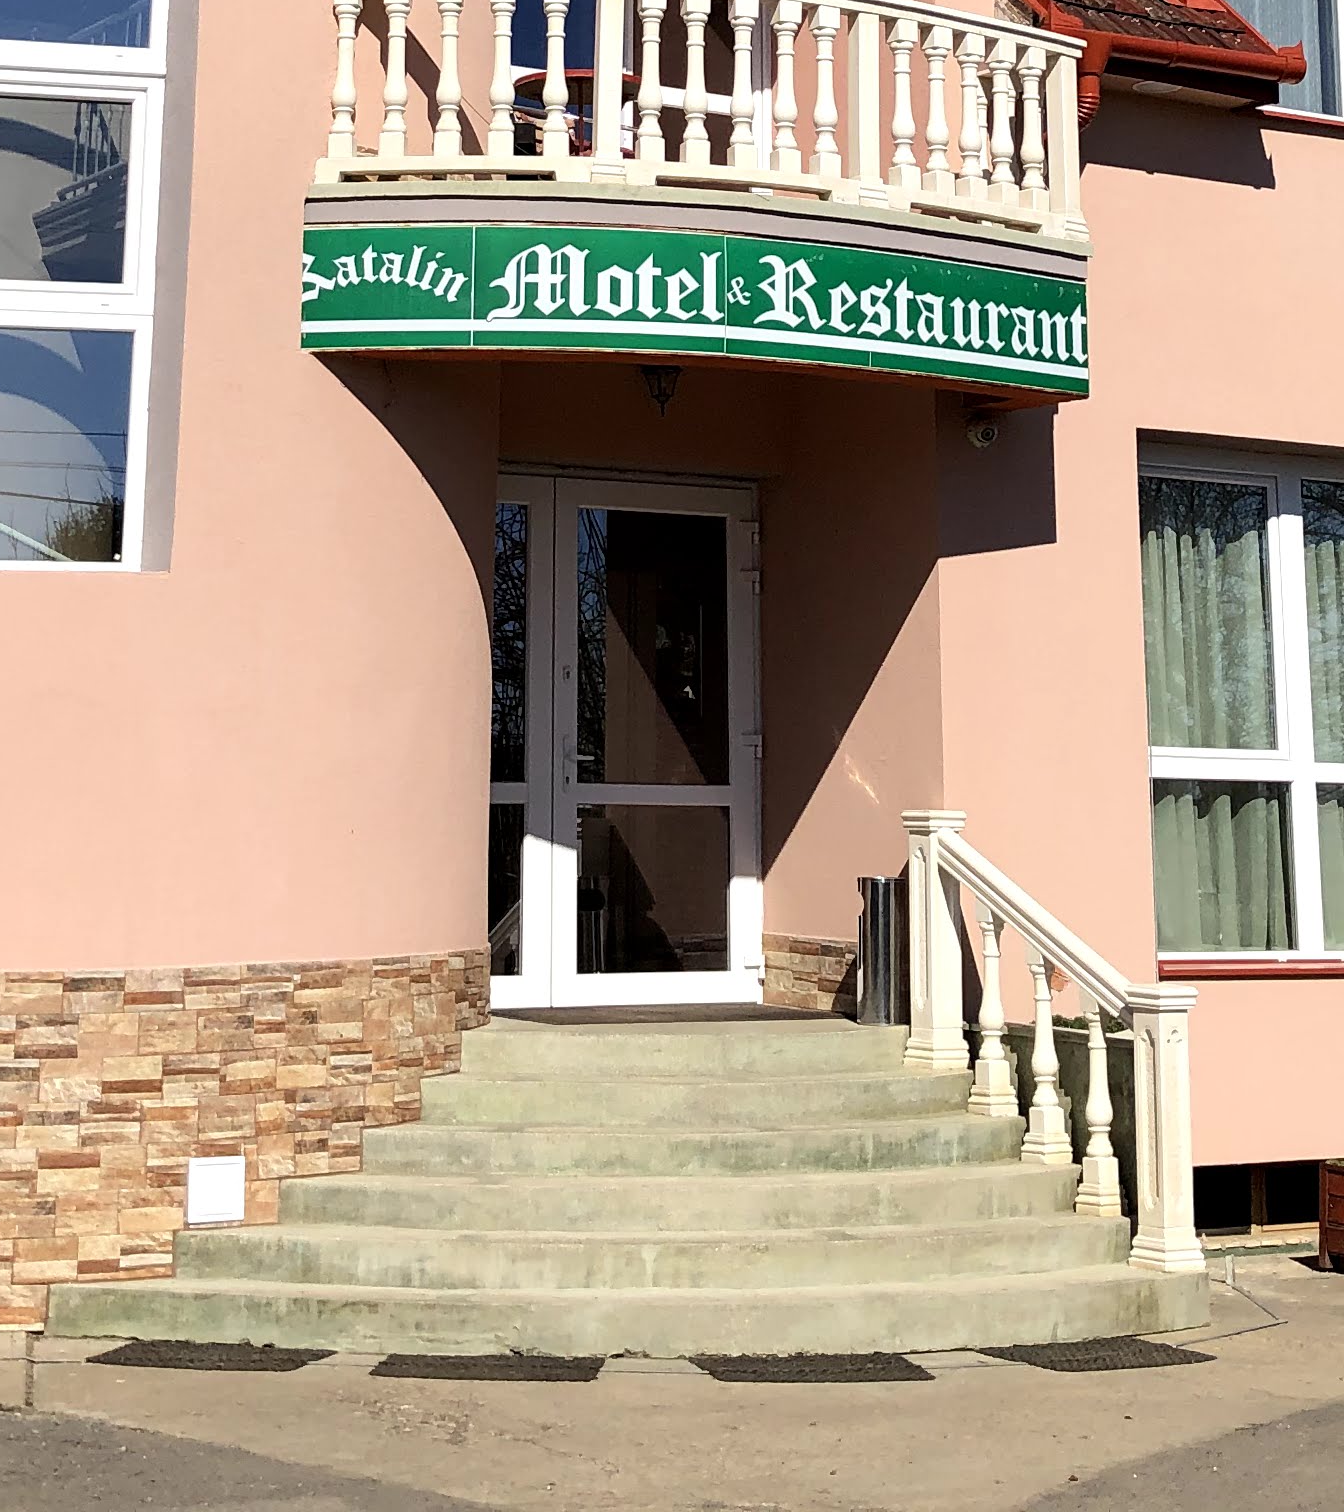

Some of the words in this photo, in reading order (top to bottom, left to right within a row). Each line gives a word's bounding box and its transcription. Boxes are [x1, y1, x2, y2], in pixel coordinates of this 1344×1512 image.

[486, 244, 725, 322] Motel
[726, 276, 752, 305] &
[753, 255, 1088, 364] Restaurant
